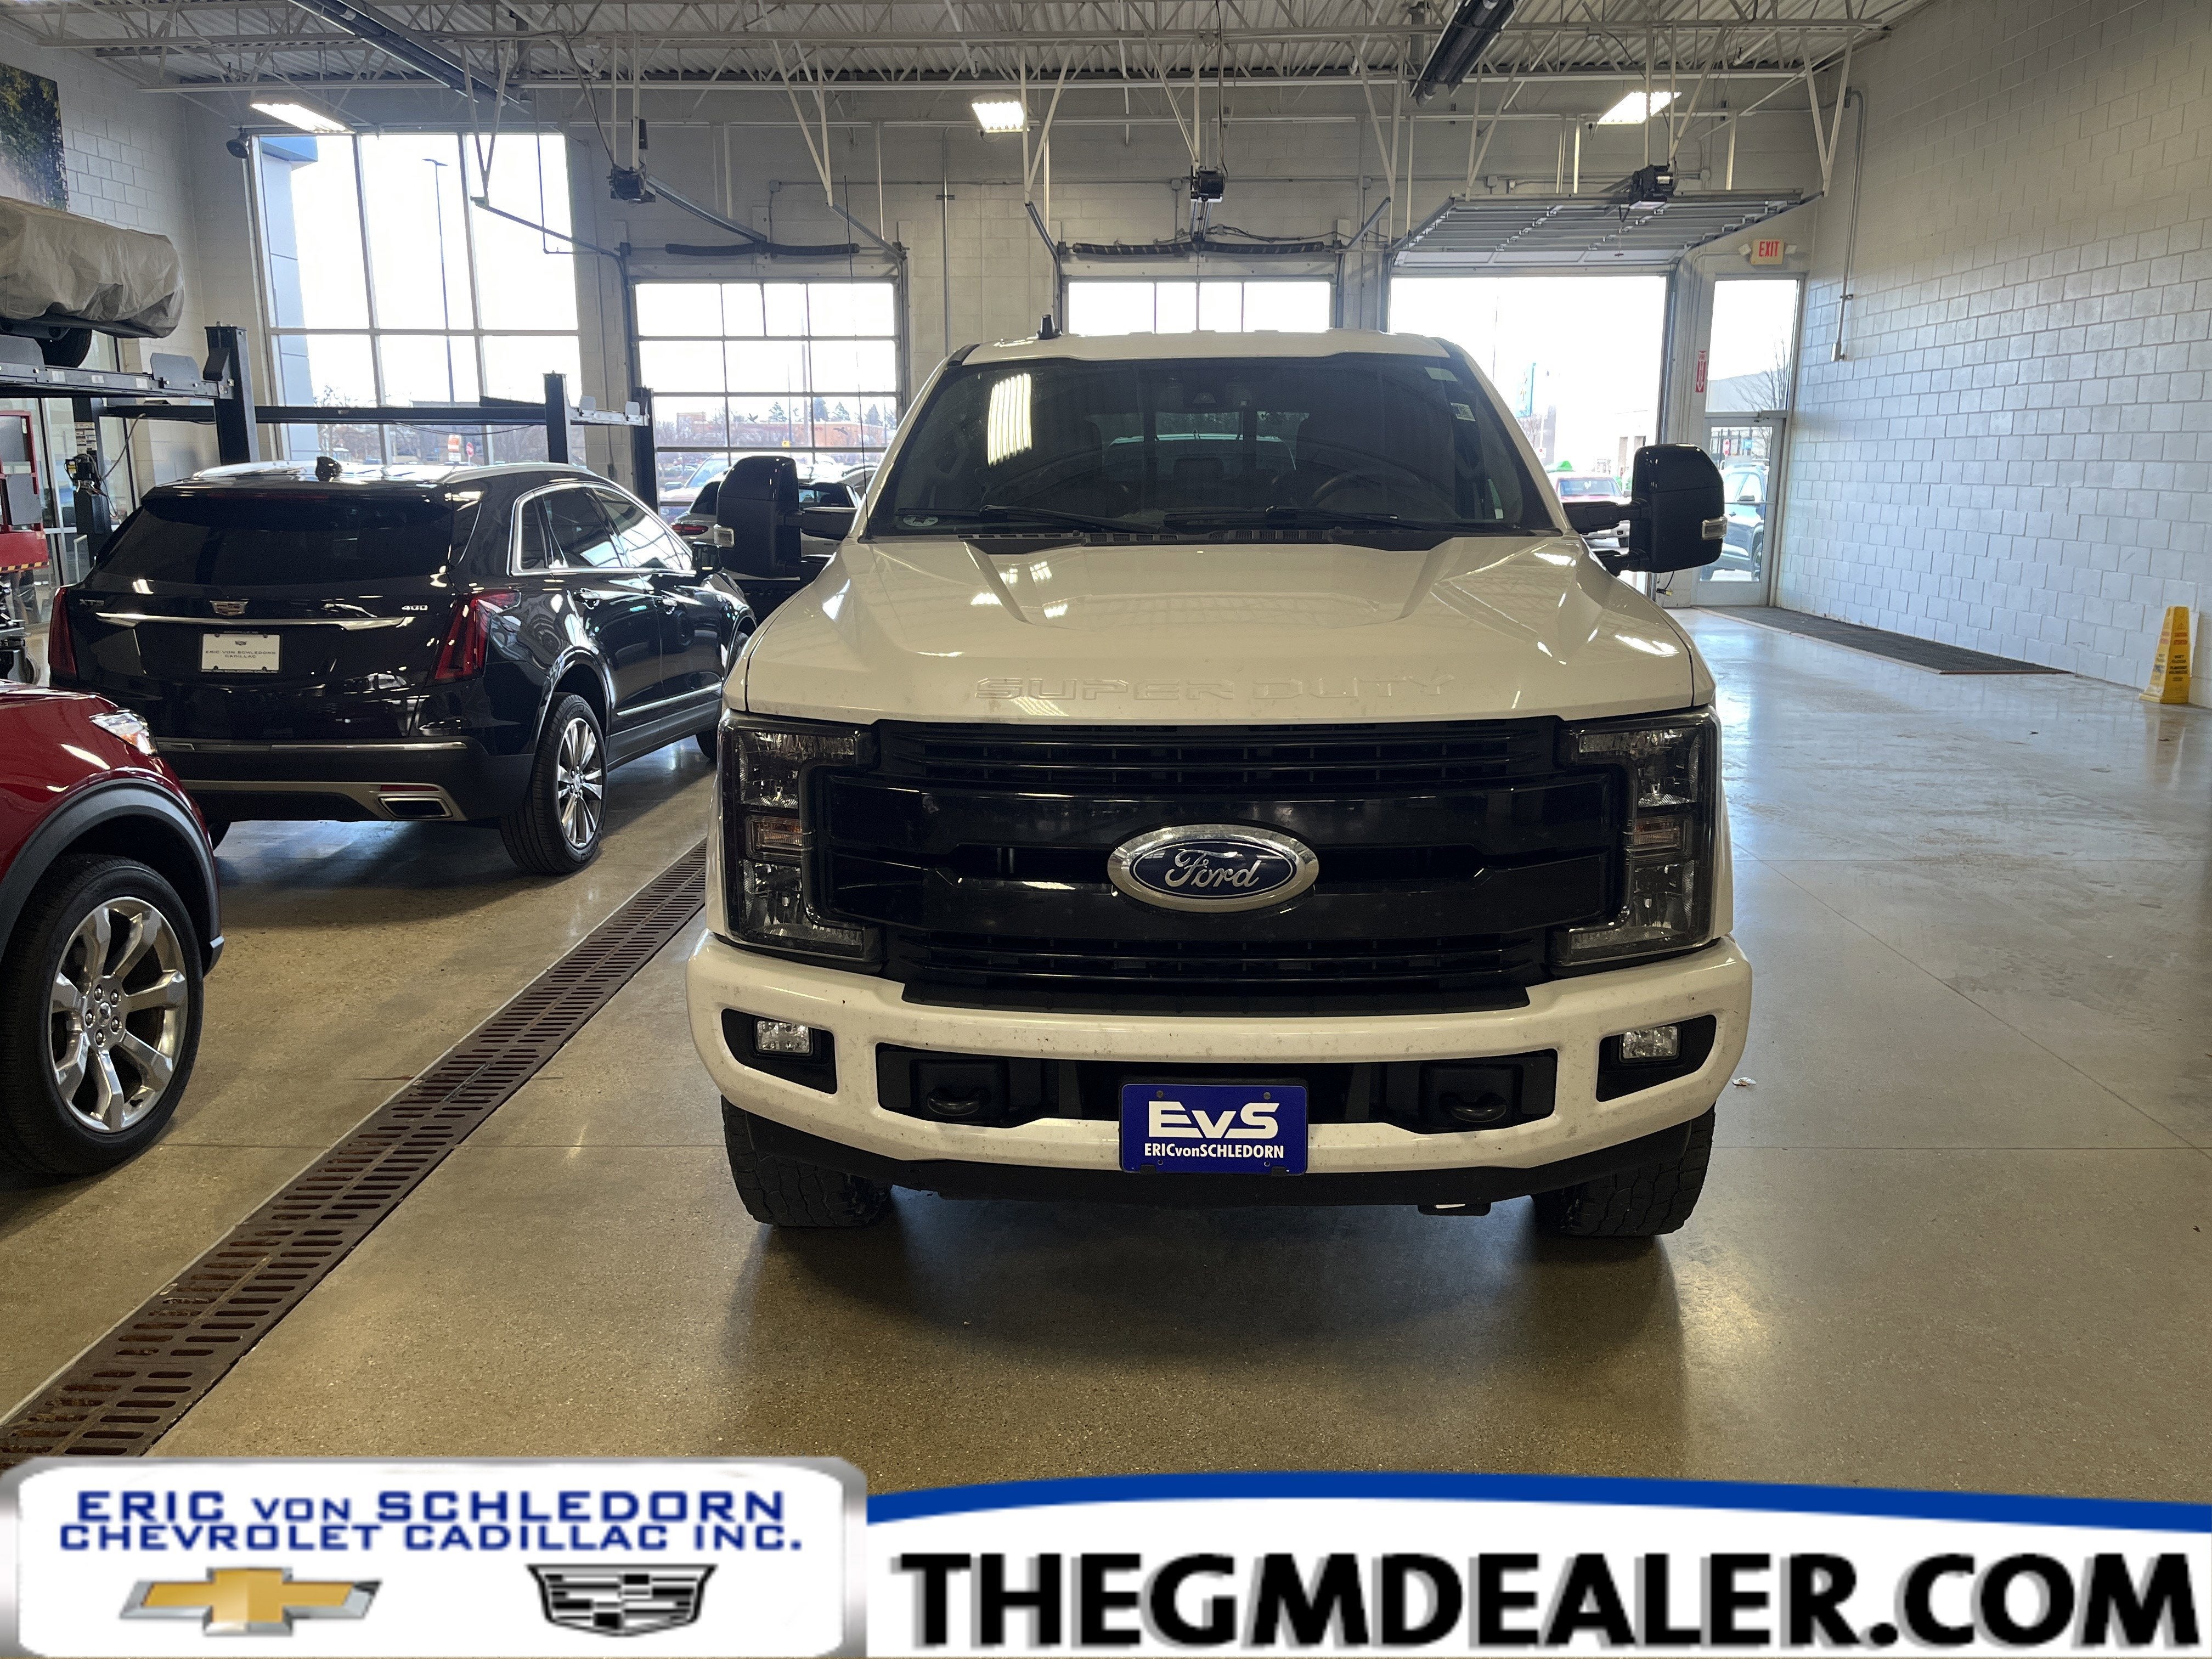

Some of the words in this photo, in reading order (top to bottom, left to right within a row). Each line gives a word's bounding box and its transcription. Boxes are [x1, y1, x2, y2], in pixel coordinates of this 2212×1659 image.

[1759, 241, 1780, 256] EXIT
[975, 678, 1235, 701] SUPER
[1253, 675, 1454, 699] DUTY
[1164, 848, 1262, 888] Ford
[1144, 1143, 1284, 1159] ERICvonSCHLEDORN
